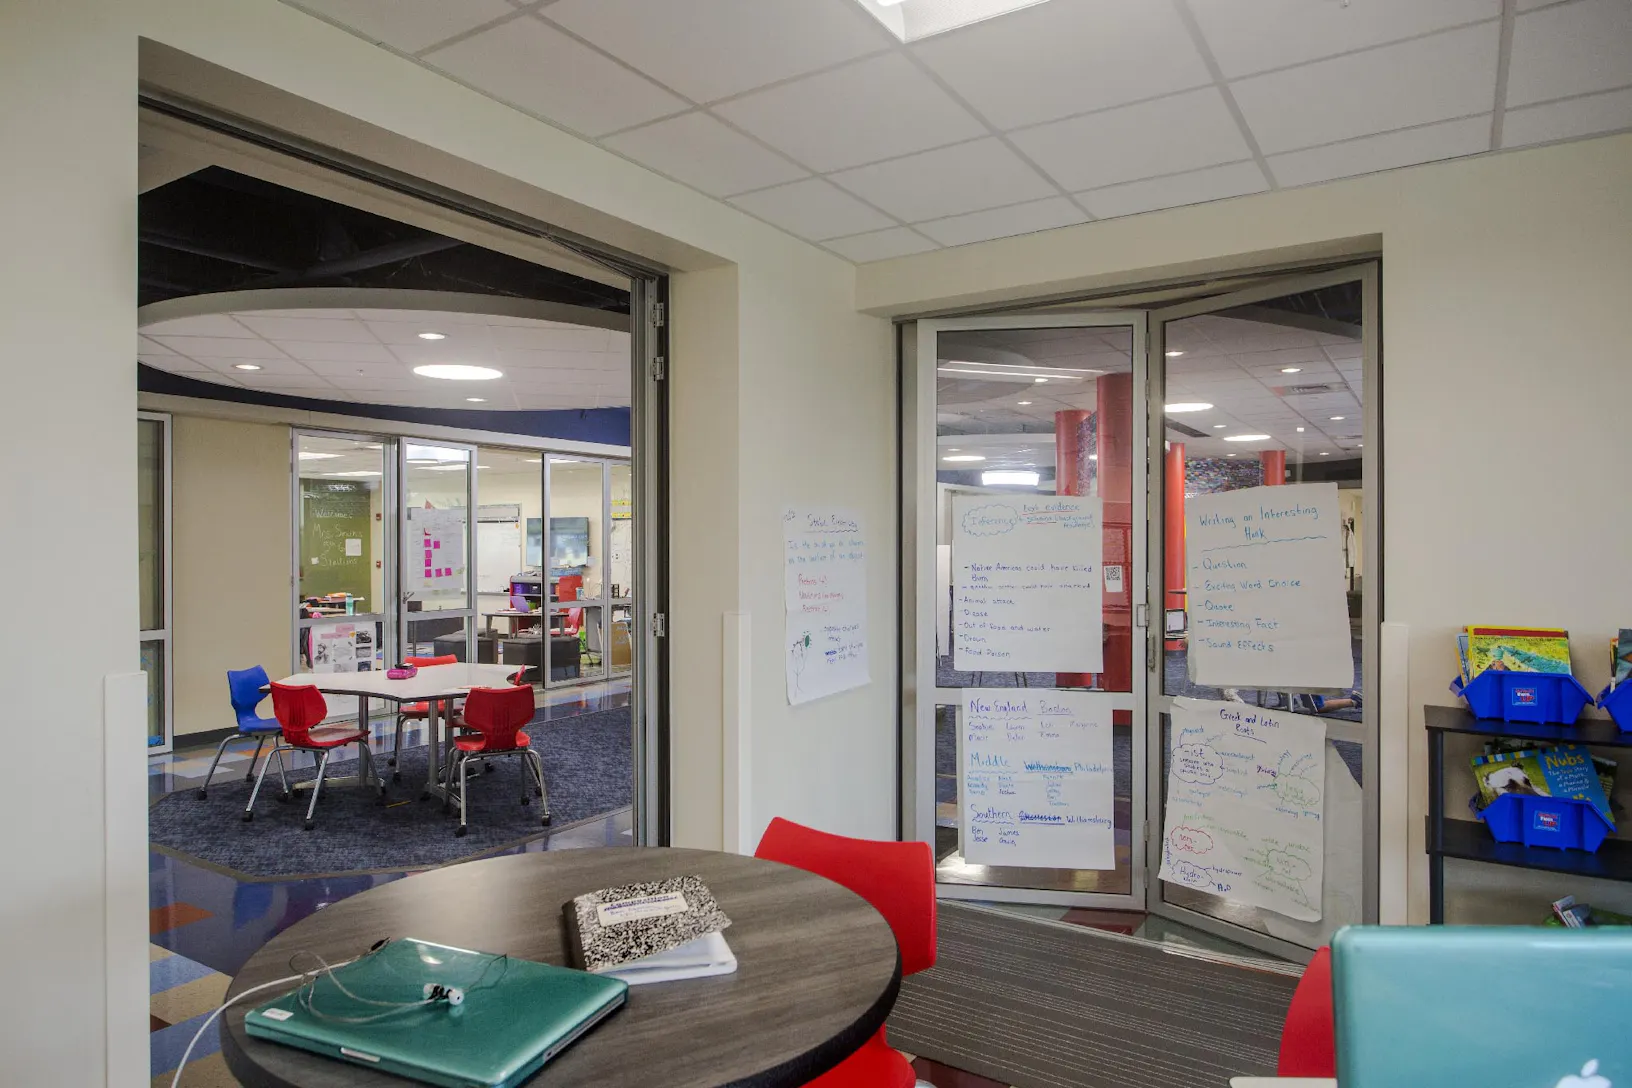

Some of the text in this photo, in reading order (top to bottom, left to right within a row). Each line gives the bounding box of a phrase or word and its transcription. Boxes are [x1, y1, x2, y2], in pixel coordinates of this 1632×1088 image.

[1199, 503, 1319, 529] Writing an Interesting
[1244, 526, 1266, 540] Hook
[1026, 563, 1045, 572] could
[1051, 563, 1069, 572] have
[1202, 557, 1248, 571] Question
[1204, 578, 1301, 593] Exciting Word Choice
[964, 622, 976, 630] Out
[1010, 624, 1024, 632] and
[1206, 618, 1280, 635] Interesting Fact
[1206, 637, 1274, 653] Sound Effects
[969, 698, 1028, 716] New England
[1245, 713, 1257, 724] and
[1260, 716, 1280, 729] Latin
[970, 752, 1012, 768] Middle
[1545, 752, 1585, 769] Nubs
[970, 804, 1014, 821] Southern
[1066, 815, 1112, 829] Williamsburg
[998, 827, 1020, 836] James
[973, 835, 989, 844] Jesse
